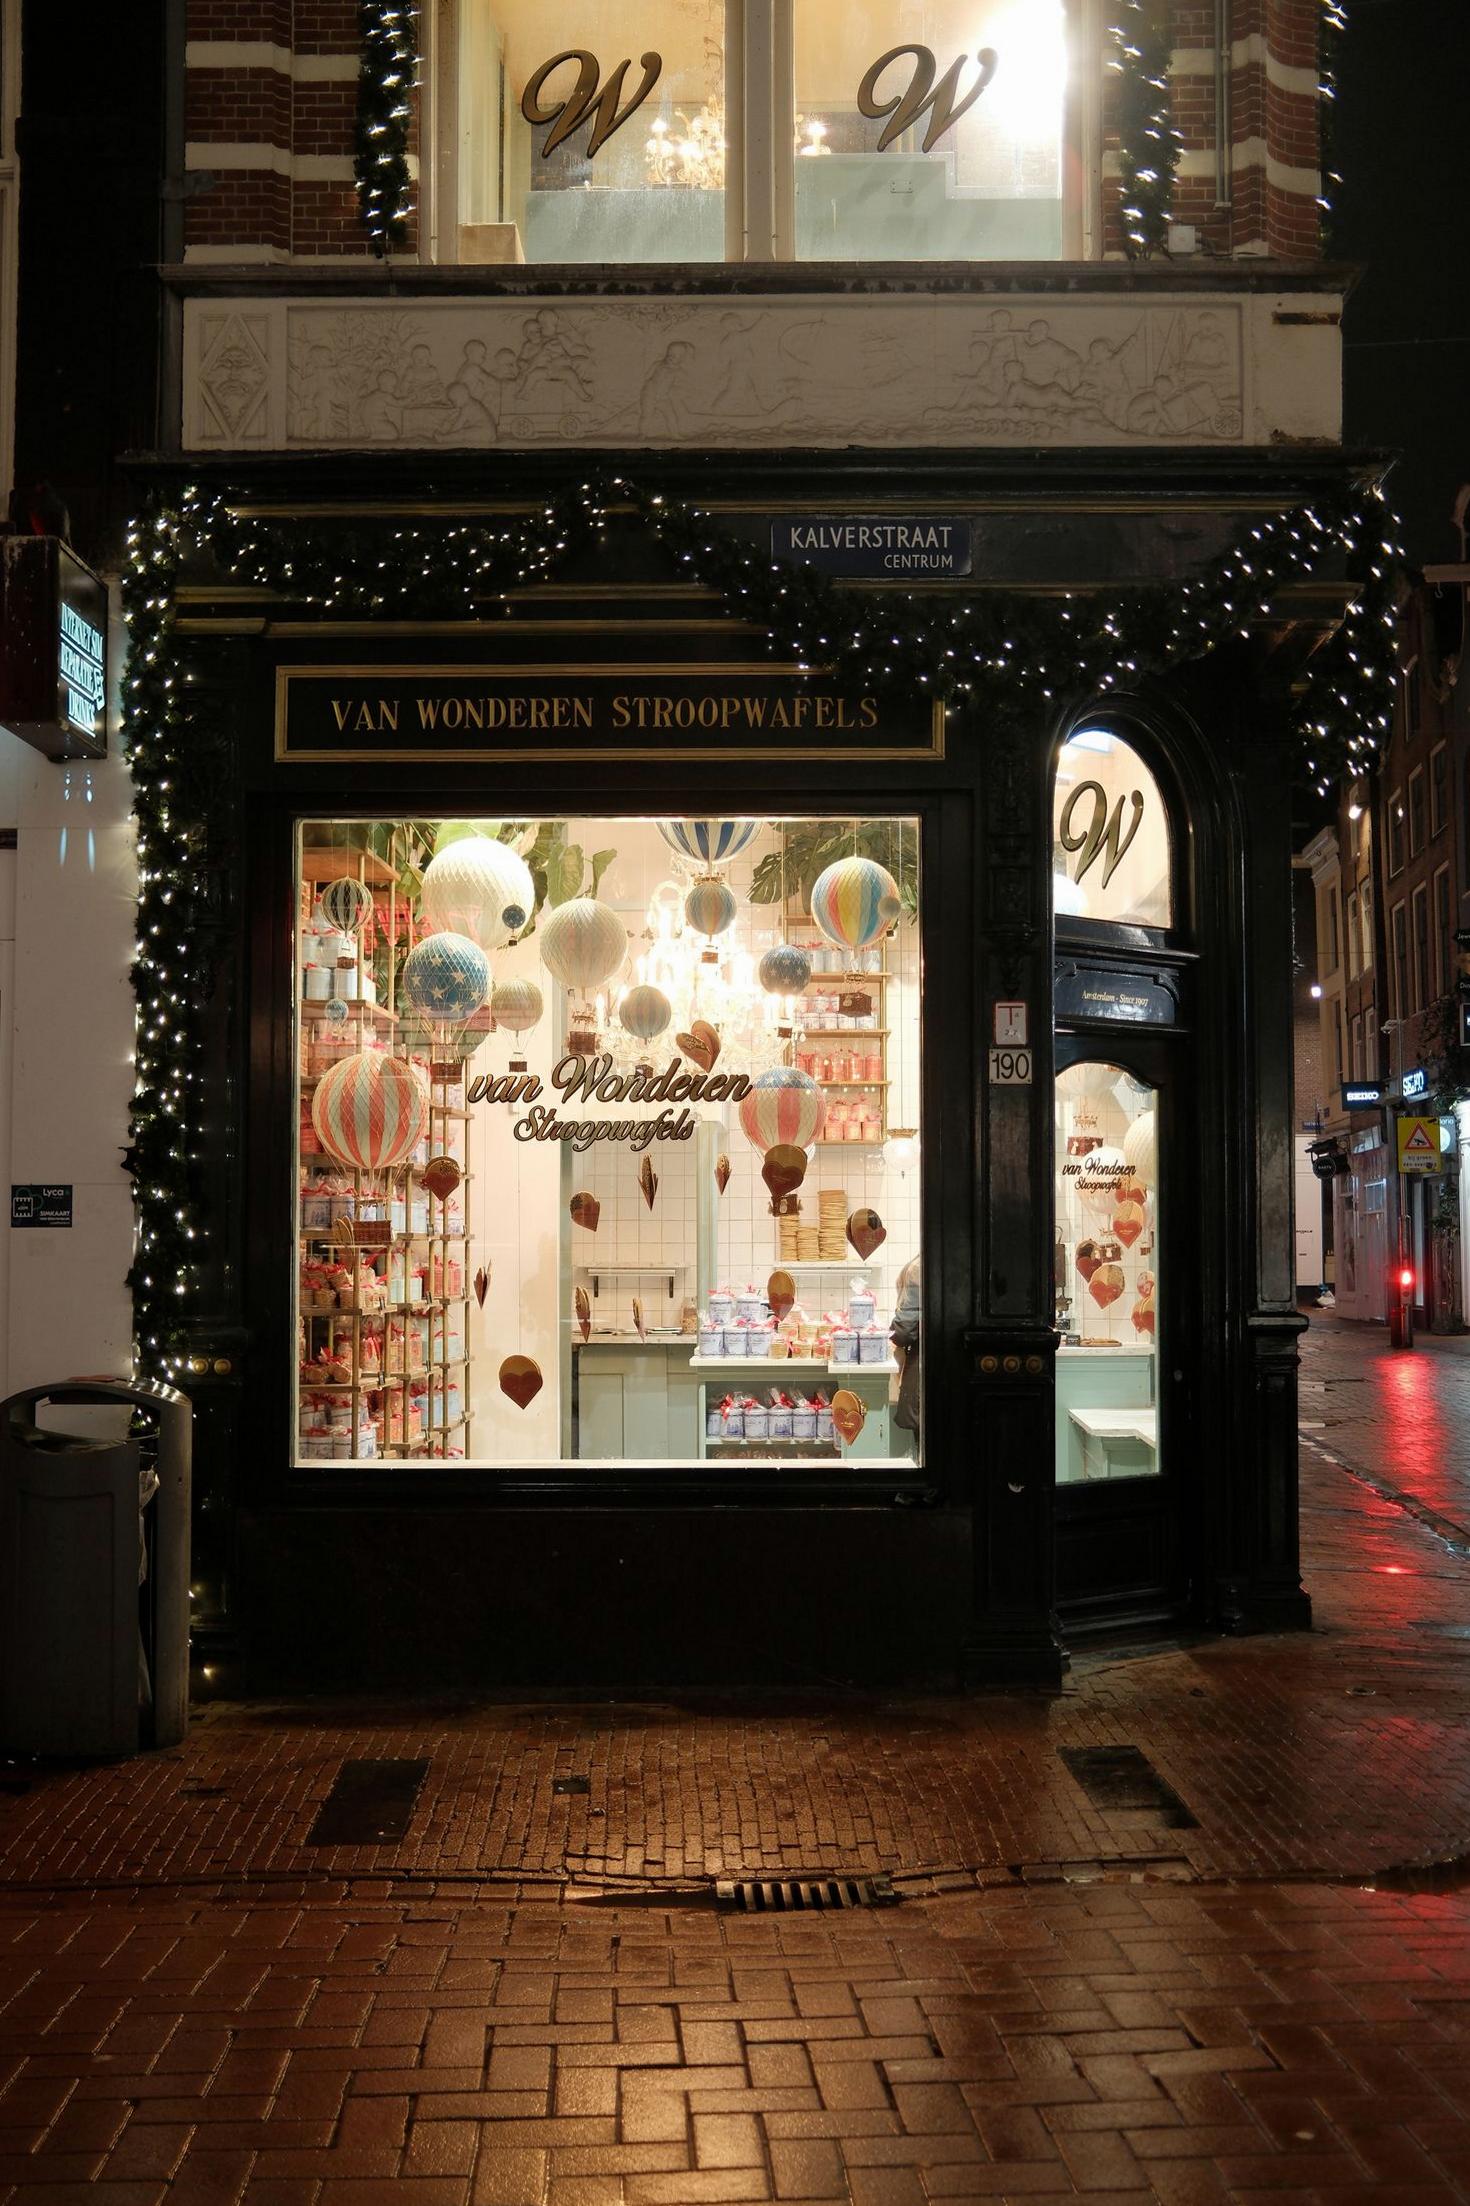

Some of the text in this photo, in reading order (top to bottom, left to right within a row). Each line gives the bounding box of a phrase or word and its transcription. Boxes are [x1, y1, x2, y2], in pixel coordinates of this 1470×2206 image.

[522, 50, 662, 158] W
[857, 44, 998, 153] W
[791, 526, 952, 549] KALVERSTRAAT
[884, 555, 953, 568] CENTRUM
[331, 696, 879, 731] VAN WONDEREN STROOPWAFELS
[1060, 780, 1144, 890] W
[1081, 990, 1115, 1002] Amsterdam
[1120, 994, 1134, 1004] Since
[1135, 997, 1149, 1007] 1907
[467, 1053, 753, 1104] van Wonderen
[992, 1053, 1029, 1079] 190
[513, 1105, 695, 1152] Stroopwafels
[1062, 1157, 1136, 1176] van Wonderen
[42, 1188, 64, 1197] Lyca
